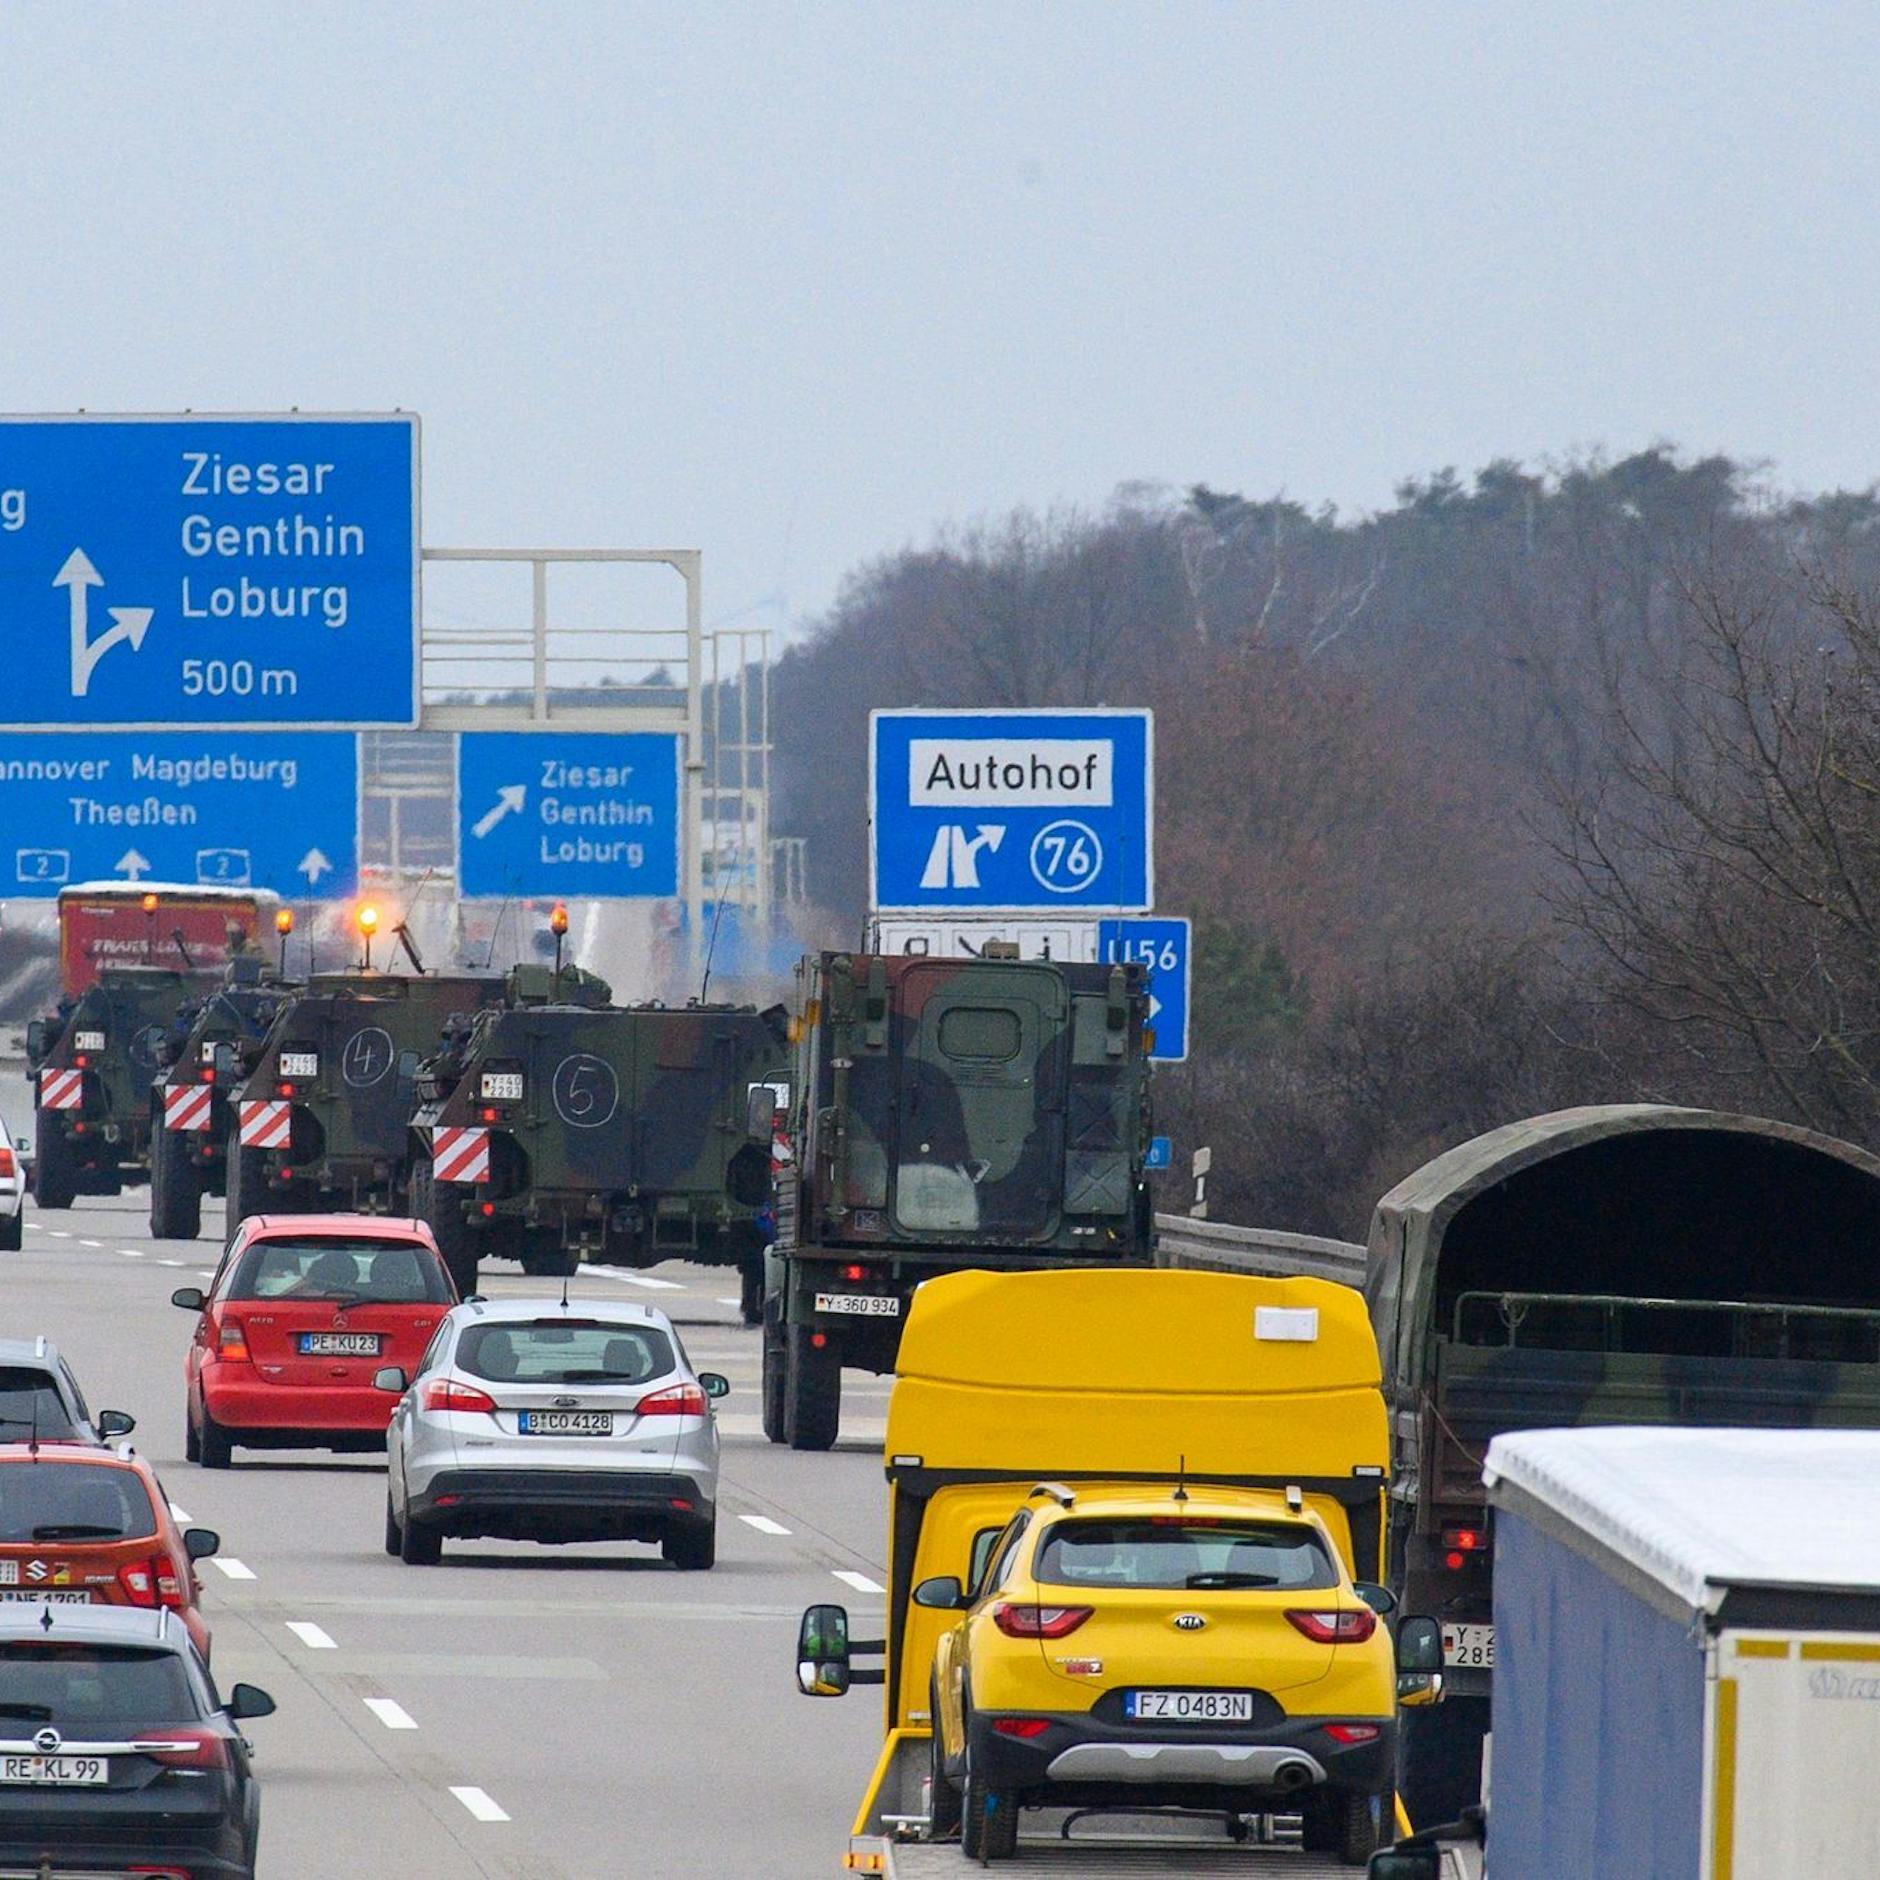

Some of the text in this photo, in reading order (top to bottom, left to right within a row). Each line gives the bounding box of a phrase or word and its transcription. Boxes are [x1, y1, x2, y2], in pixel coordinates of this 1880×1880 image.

[181, 452, 335, 495] Ziesar
[181, 514, 365, 556] Genthin
[181, 576, 349, 628] Loburg
[182, 660, 298, 695] 500 m
[132, 754, 297, 787] Magdeburg
[540, 760, 634, 788] Ziesar
[926, 754, 1098, 790] Autohof
[68, 797, 197, 826] Theeßen
[539, 796, 654, 826] Genthin
[36, 856, 49, 876] 2
[216, 856, 228, 876] 2
[540, 834, 644, 868] Loburg
[1044, 837, 1091, 877] 76
[1108, 939, 1178, 971] U56
[353, 1035, 376, 1073] 4
[569, 1065, 597, 1115] 5
[311, 1336, 330, 1349] PE
[359, 1337, 376, 1350] 23
[529, 1414, 539, 1429] B
[572, 1415, 610, 1430] 4128
[1178, 1617, 1201, 1627] KIA
[1457, 1627, 1467, 1643] Y
[1140, 1694, 1169, 1716] FZ
[1177, 1696, 1246, 1717] 0483N
[6, 1759, 99, 1779] RE KL 99
